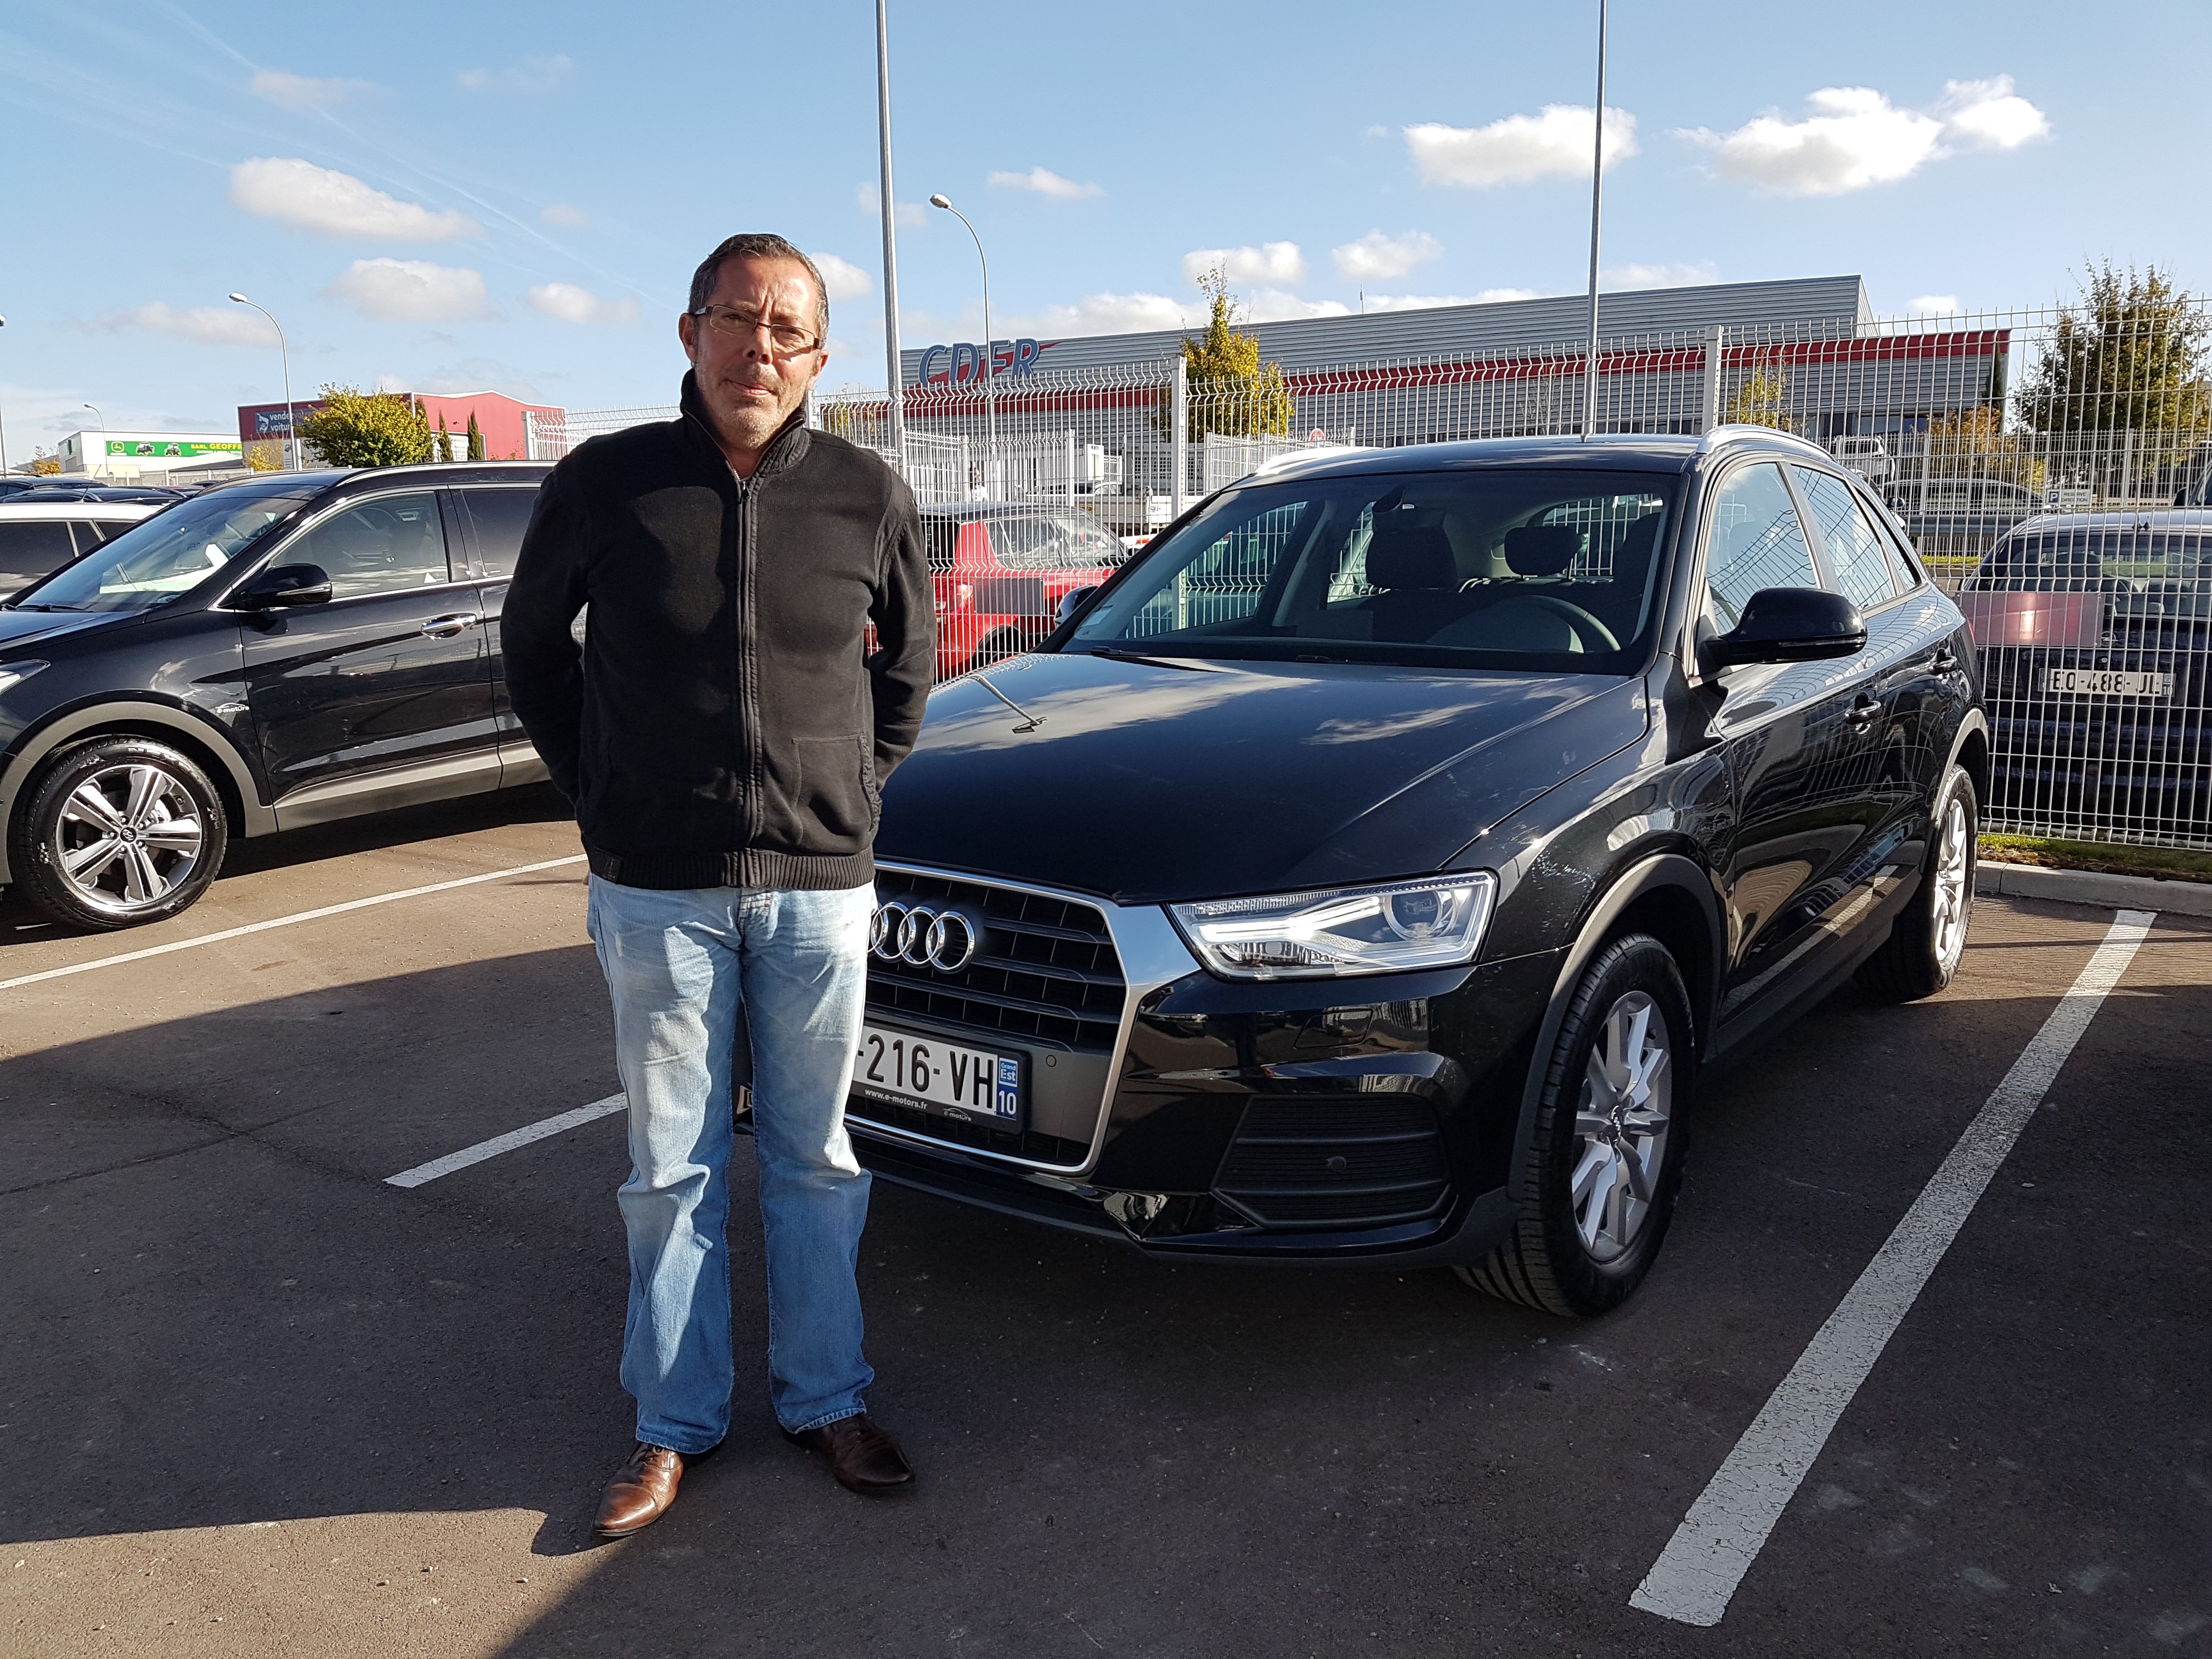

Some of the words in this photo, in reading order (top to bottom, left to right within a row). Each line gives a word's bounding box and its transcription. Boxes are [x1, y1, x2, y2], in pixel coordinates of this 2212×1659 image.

[918, 338, 1041, 390] CDER
[2050, 493, 2058, 501] P
[1001, 1063, 1016, 1071] Grand
[1001, 1068, 1015, 1081] Est
[865, 1088, 928, 1110] www.e-motors.fr
[999, 1090, 1017, 1115] 10
